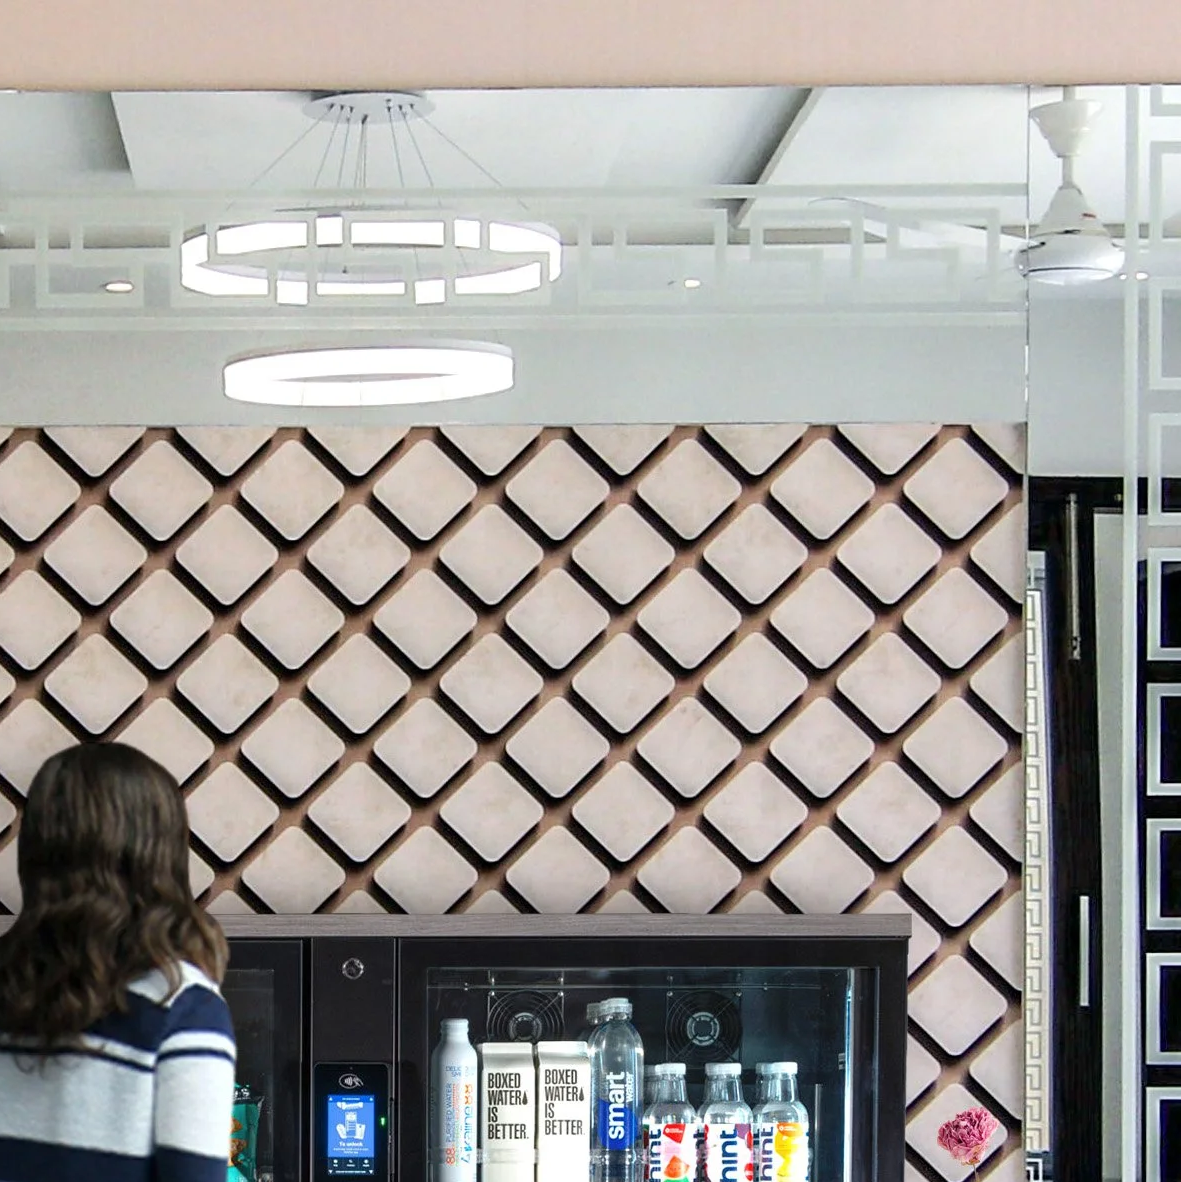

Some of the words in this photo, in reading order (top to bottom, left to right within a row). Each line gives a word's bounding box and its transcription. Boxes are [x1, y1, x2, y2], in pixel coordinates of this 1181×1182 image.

[488, 1073, 521, 1089] BOXED
[544, 1069, 578, 1085] BOXED
[544, 1086, 579, 1102] WATER
[626, 1071, 634, 1103] water
[488, 1090, 522, 1106] WATER
[606, 1071, 625, 1140] smart
[488, 1106, 498, 1123] IS
[544, 1102, 555, 1118] IS
[760, 1126, 774, 1182] hint
